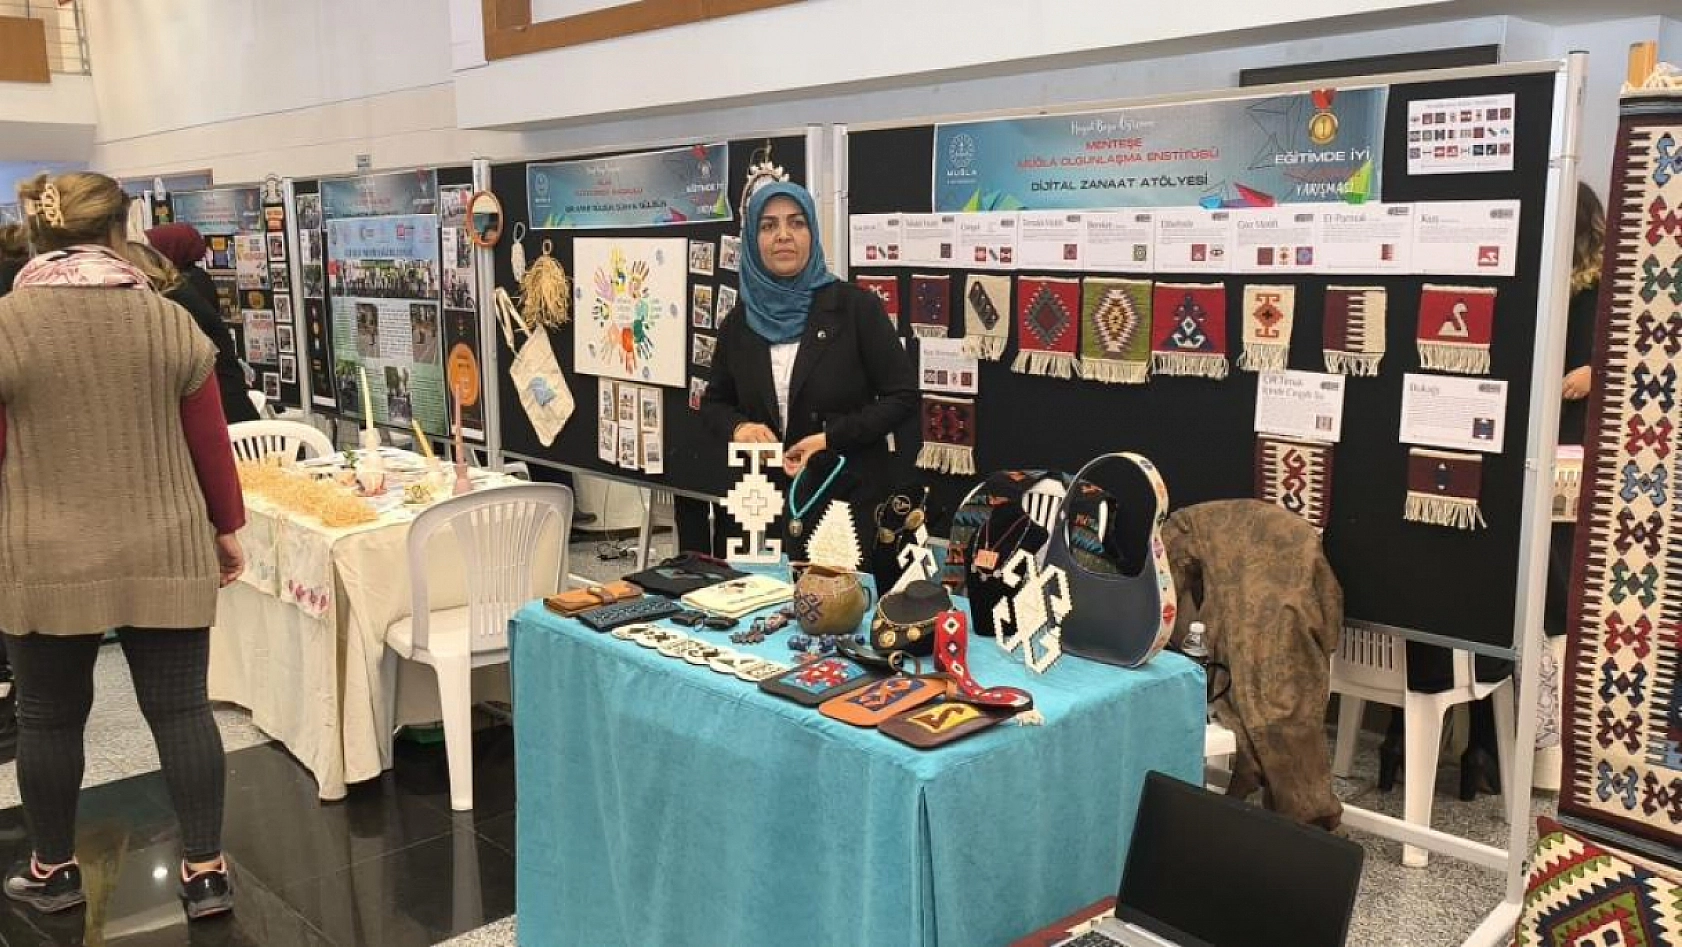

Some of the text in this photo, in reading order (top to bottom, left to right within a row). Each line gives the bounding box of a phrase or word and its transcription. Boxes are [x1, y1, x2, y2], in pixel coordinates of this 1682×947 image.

[1085, 137, 1143, 150] MENTEŞE
[1061, 151, 1143, 167] OLGUNLAŞMA
[1147, 146, 1219, 163] ENSTİTÜSÜ
[1275, 145, 1371, 164] EĞİTİMDE İYİ
[1031, 171, 1208, 192] DİJİTAL ZANAAT ATÖLYESİ
